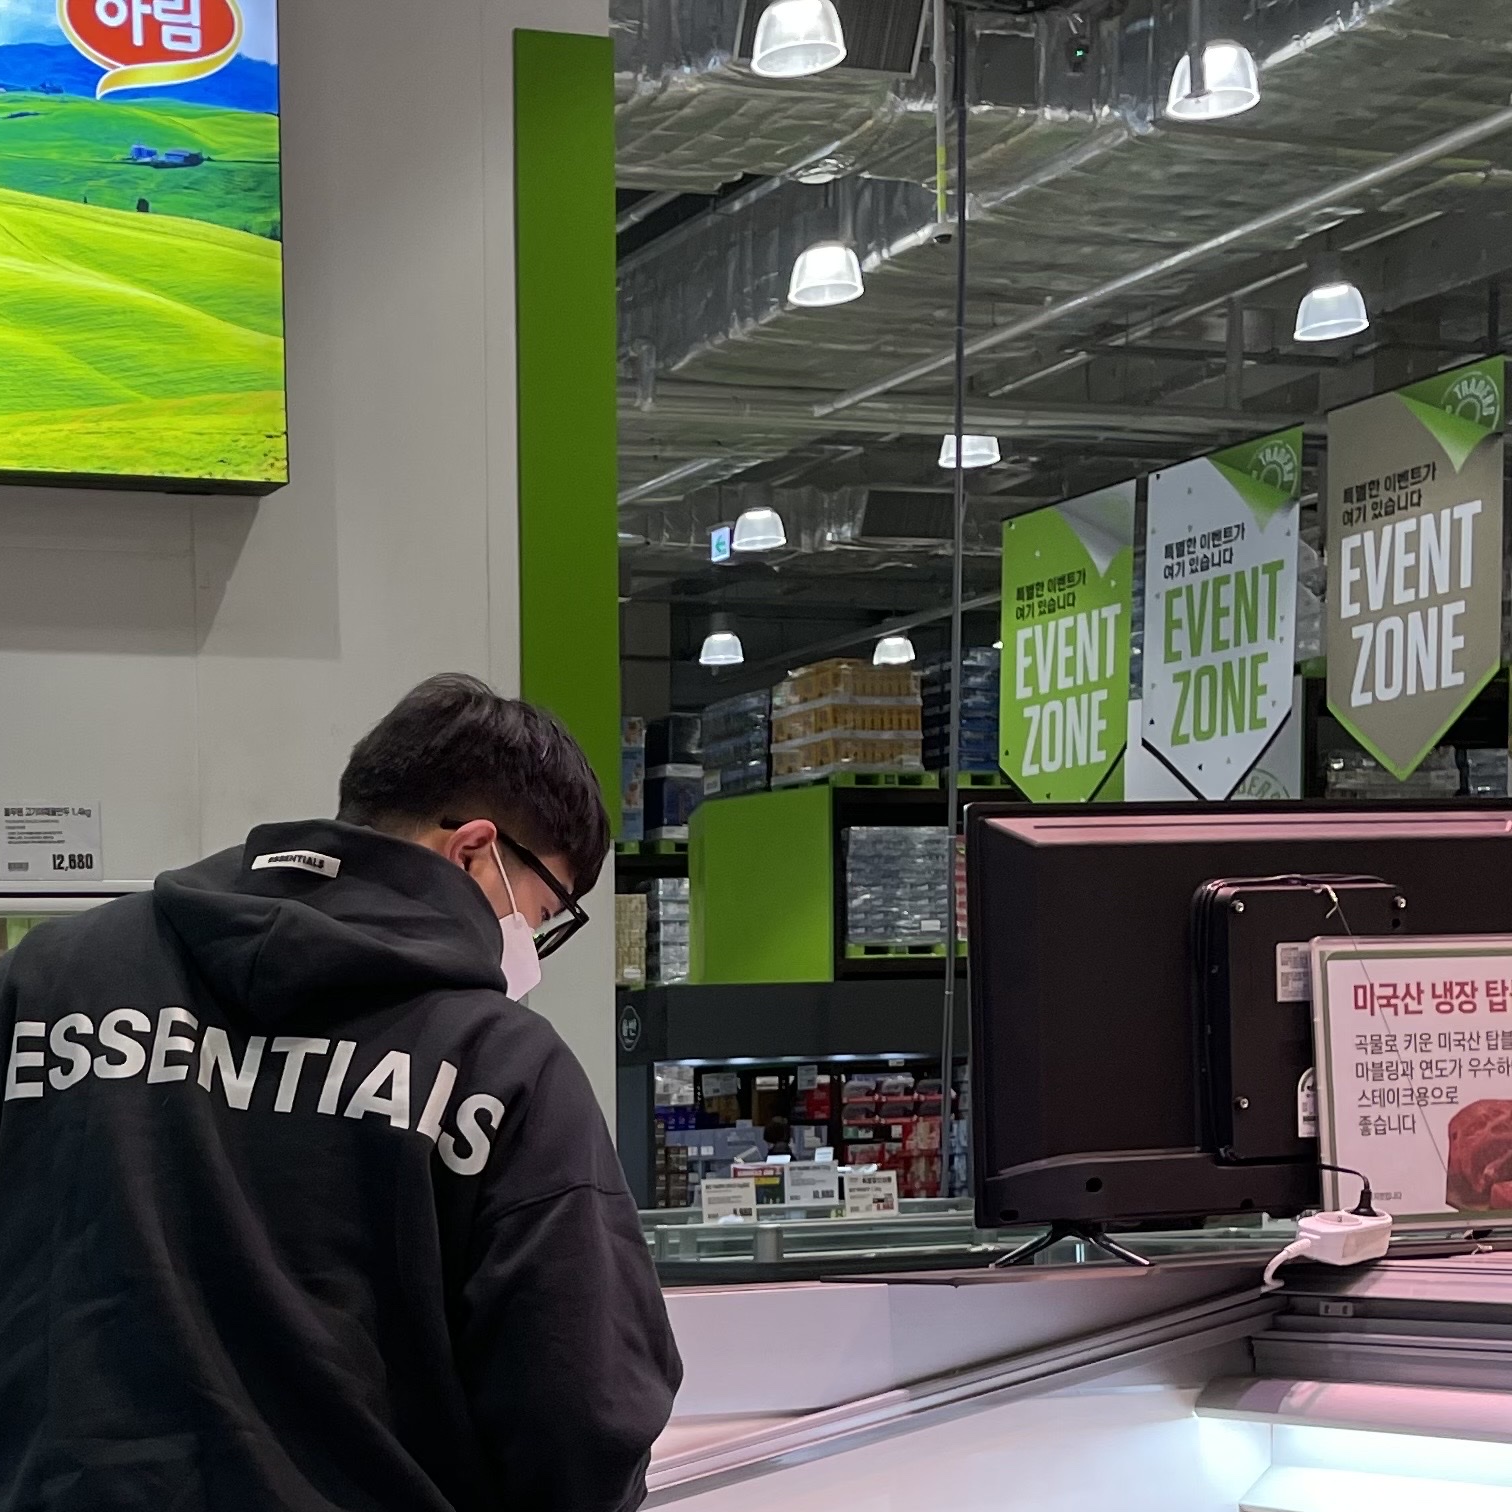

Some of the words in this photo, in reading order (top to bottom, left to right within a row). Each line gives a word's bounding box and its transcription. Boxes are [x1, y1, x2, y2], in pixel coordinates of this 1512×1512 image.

[1343, 478, 1381, 505] 특별한
[1384, 461, 1437, 493] 이벤트가
[1342, 505, 1367, 527] 여기
[1372, 488, 1423, 520] 있습니다
[1164, 535, 1197, 561] 특별한
[1199, 522, 1246, 550] 이벤트가
[1339, 499, 1482, 620] EVENT
[1163, 559, 1186, 580] 여기
[1188, 547, 1234, 575] 있습니다
[1016, 581, 1045, 602] 특별한
[1046, 568, 1087, 594] 이벤트가
[1015, 603, 1035, 621] 여기
[1037, 591, 1076, 616] 있습니다
[1163, 558, 1285, 665] EVENT
[1015, 602, 1122, 700] EVENT
[1350, 600, 1466, 708] ZONE
[1170, 652, 1269, 748] ZONE
[1021, 688, 1108, 778] ZONE
[267, 854, 325, 869] ESSENTIALS
[1353, 981, 1425, 1017] 미국산
[1431, 980, 1479, 1015] 냉장
[1485, 979, 1512, 1014] 탑
[1355, 1033, 1399, 1055] 곡물로
[1404, 1032, 1433, 1053] 키운
[1438, 1030, 1481, 1053] 미국산
[1355, 1059, 1415, 1082] 마블링과
[1419, 1058, 1463, 1080] 연도가
[5, 1006, 505, 1176] ESSENTIALS
[1357, 1085, 1459, 1108] 스테이크용으로
[1358, 1113, 1417, 1137] 좋습니다
